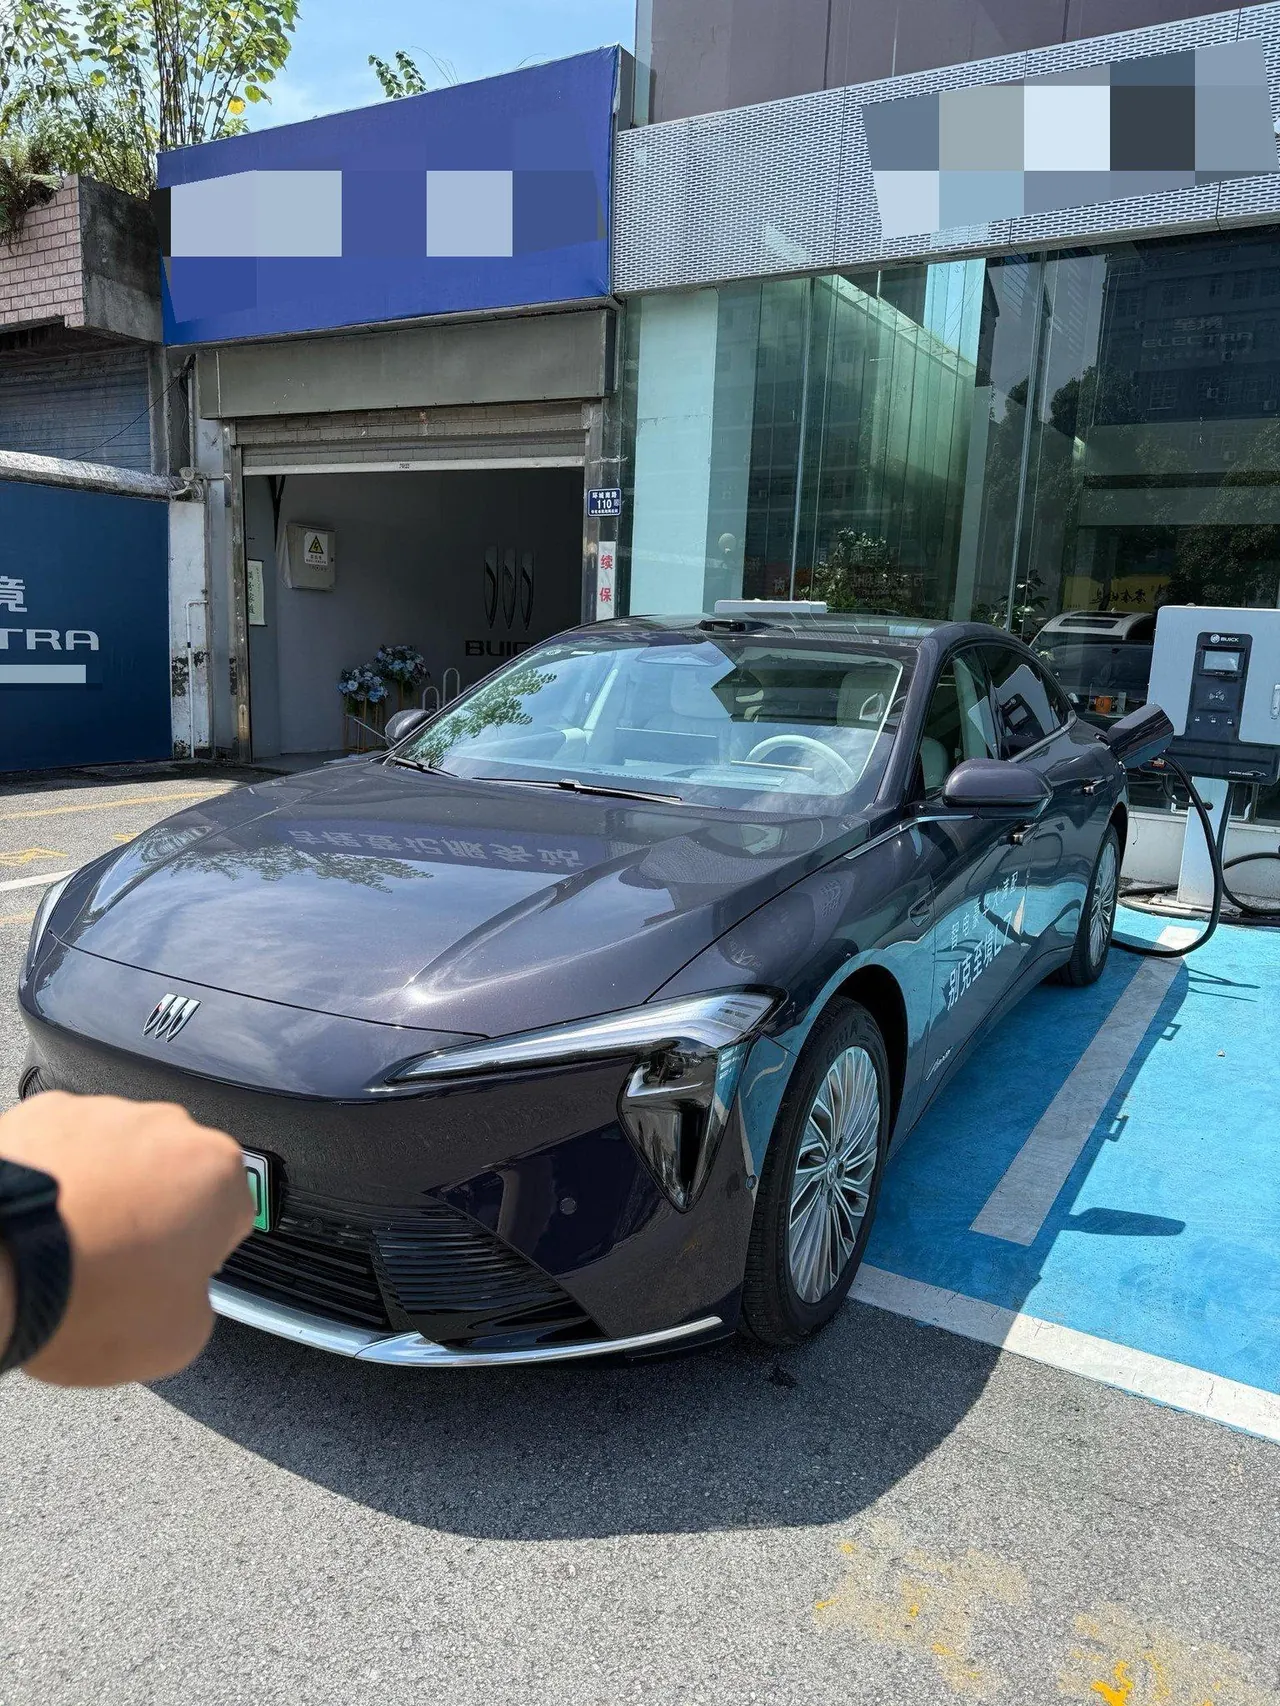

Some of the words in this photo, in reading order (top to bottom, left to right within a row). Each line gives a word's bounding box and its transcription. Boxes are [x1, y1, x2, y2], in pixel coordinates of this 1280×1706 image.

[597, 499, 612, 509] 110
[599, 554, 613, 603] 续保
[465, 640, 534, 657] BUIC
